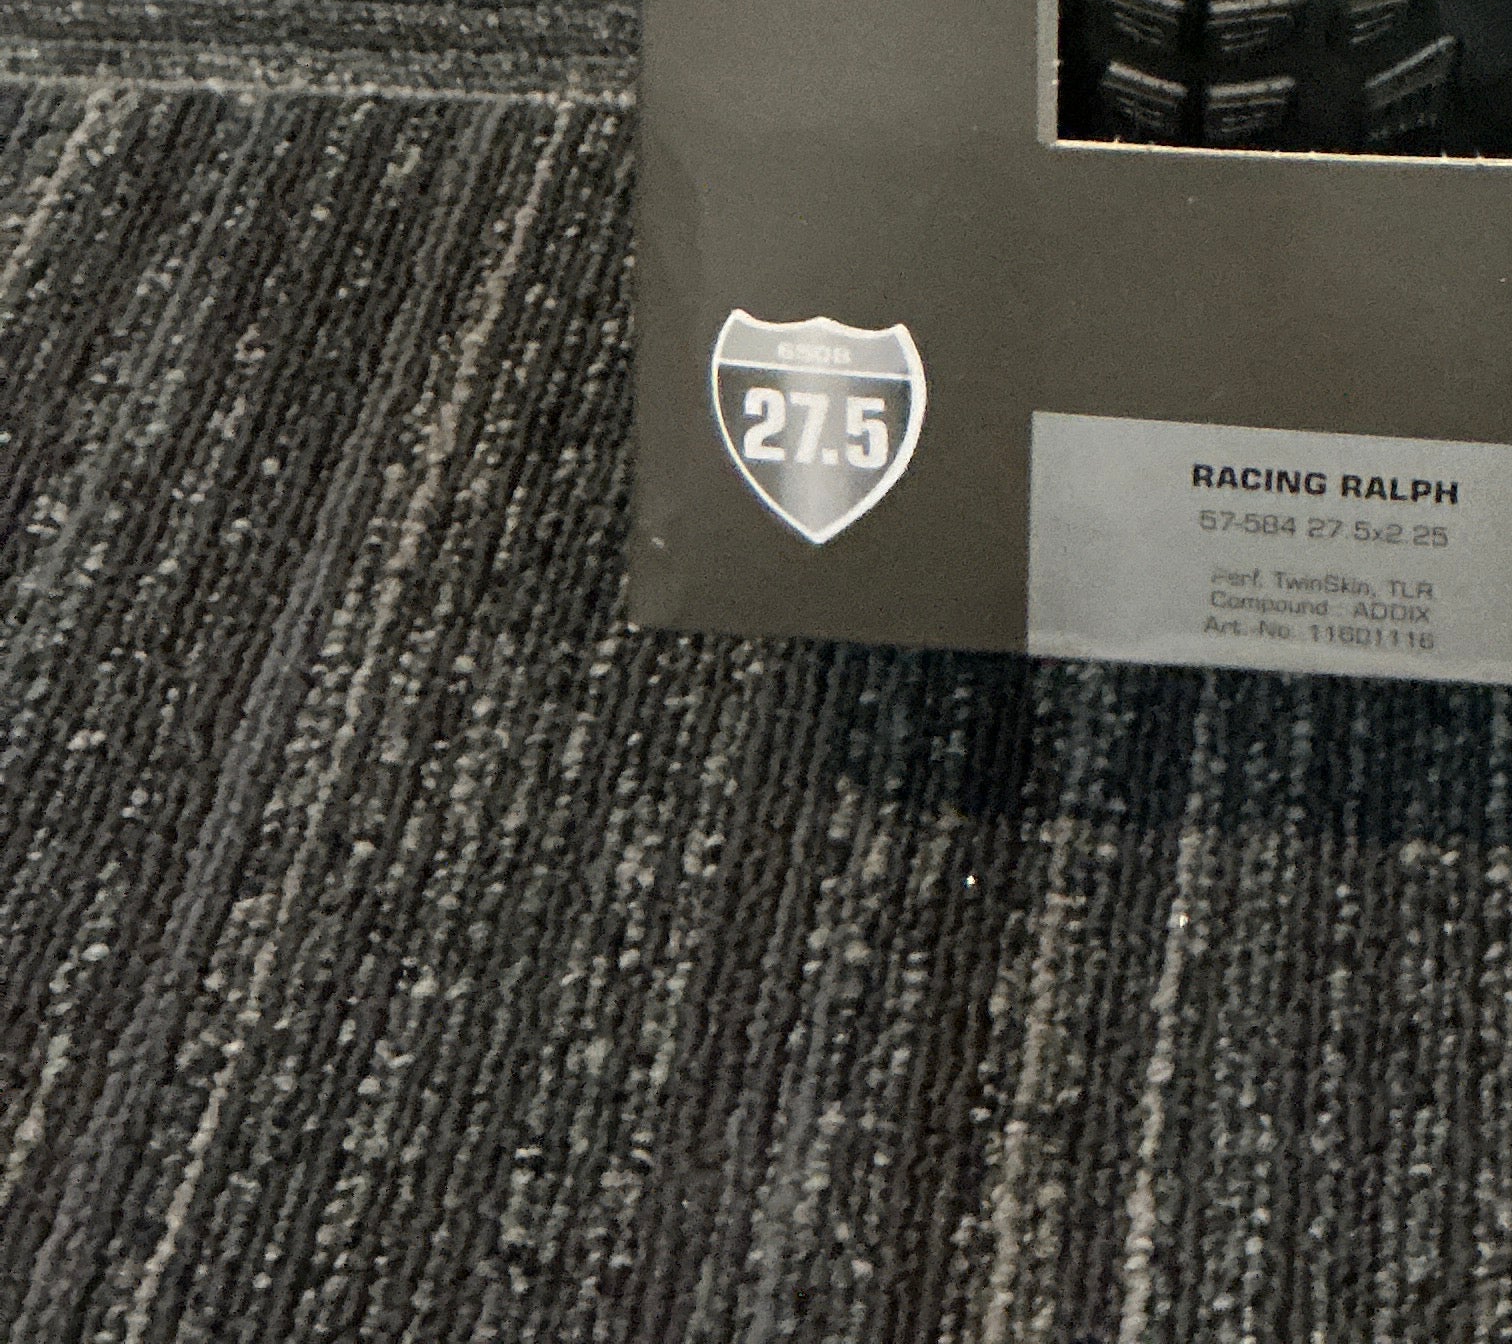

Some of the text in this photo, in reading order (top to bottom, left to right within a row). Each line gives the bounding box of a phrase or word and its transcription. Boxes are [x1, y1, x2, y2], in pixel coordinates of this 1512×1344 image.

[744, 387, 889, 469] 27.5
[1192, 463, 1459, 505] RACING RALPH
[1199, 510, 1296, 538] 57-584
[1388, 579, 1433, 600] TLR
[1354, 601, 1431, 623] ADDIX
